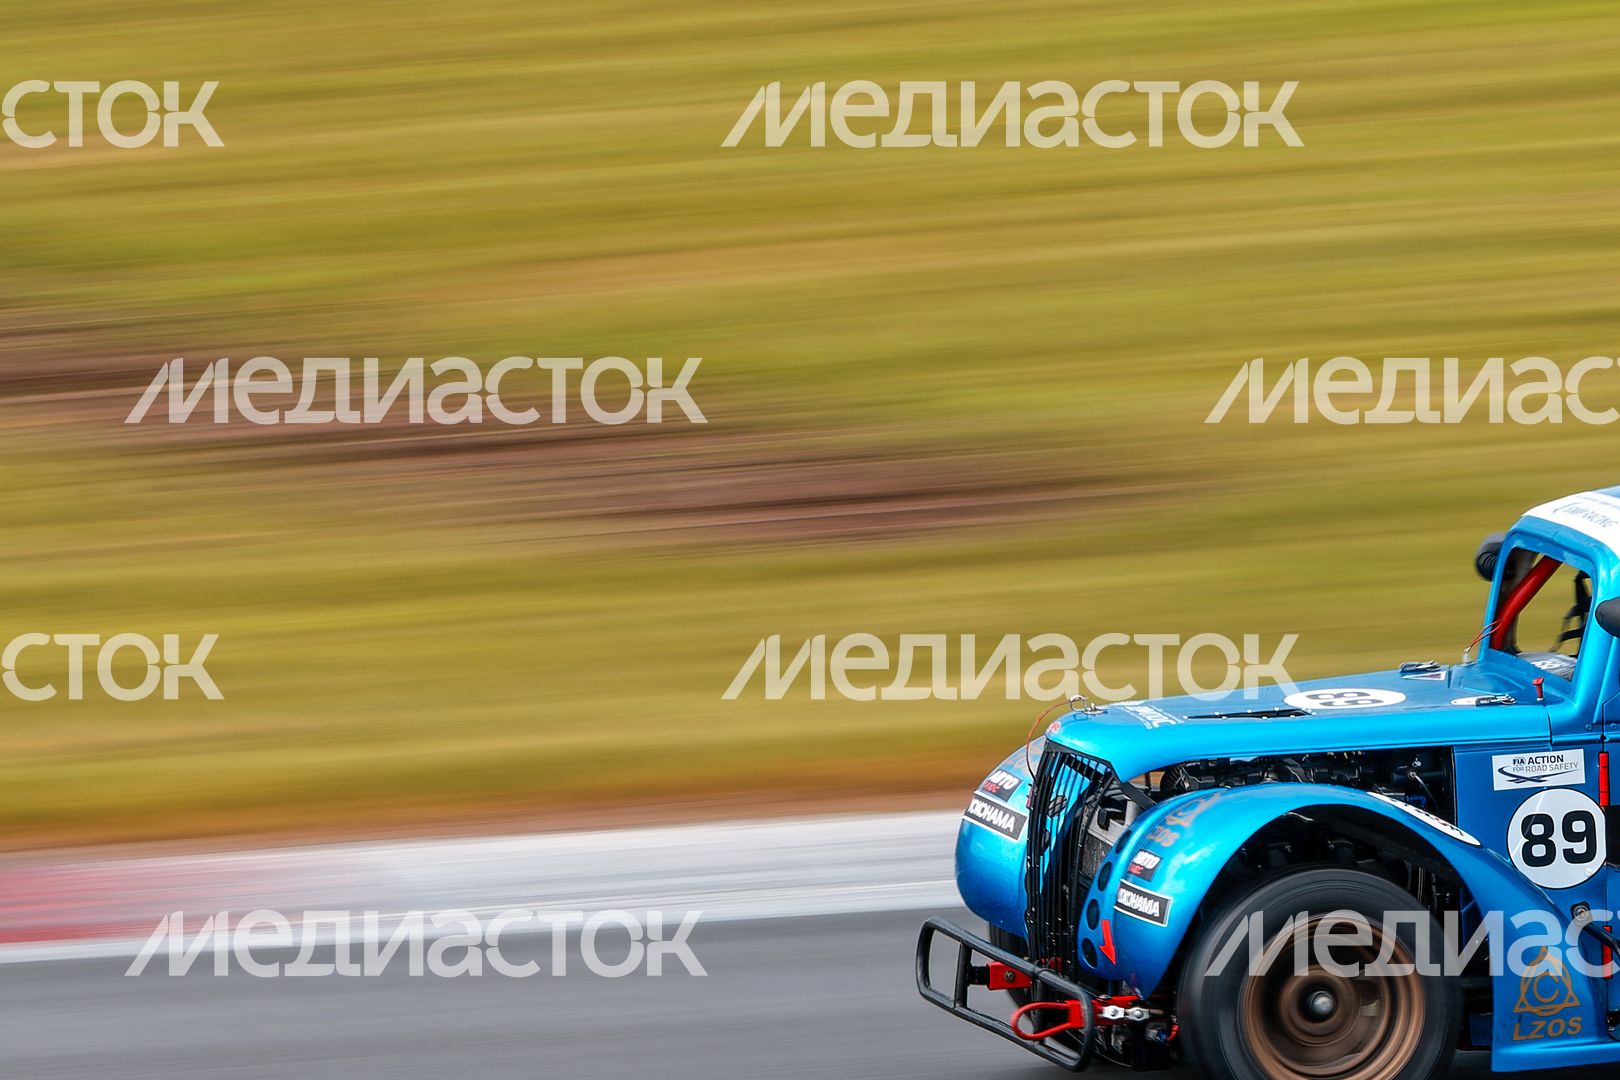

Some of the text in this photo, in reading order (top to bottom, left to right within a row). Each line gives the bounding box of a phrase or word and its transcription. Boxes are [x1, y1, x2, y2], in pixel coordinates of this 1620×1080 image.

[1525, 764, 1548, 773] ROAD
[1549, 762, 1579, 772] SAFETY
[1527, 754, 1564, 765] ACTION
[1520, 809, 1598, 868] 89
[1513, 1016, 1583, 1040] LZOS
